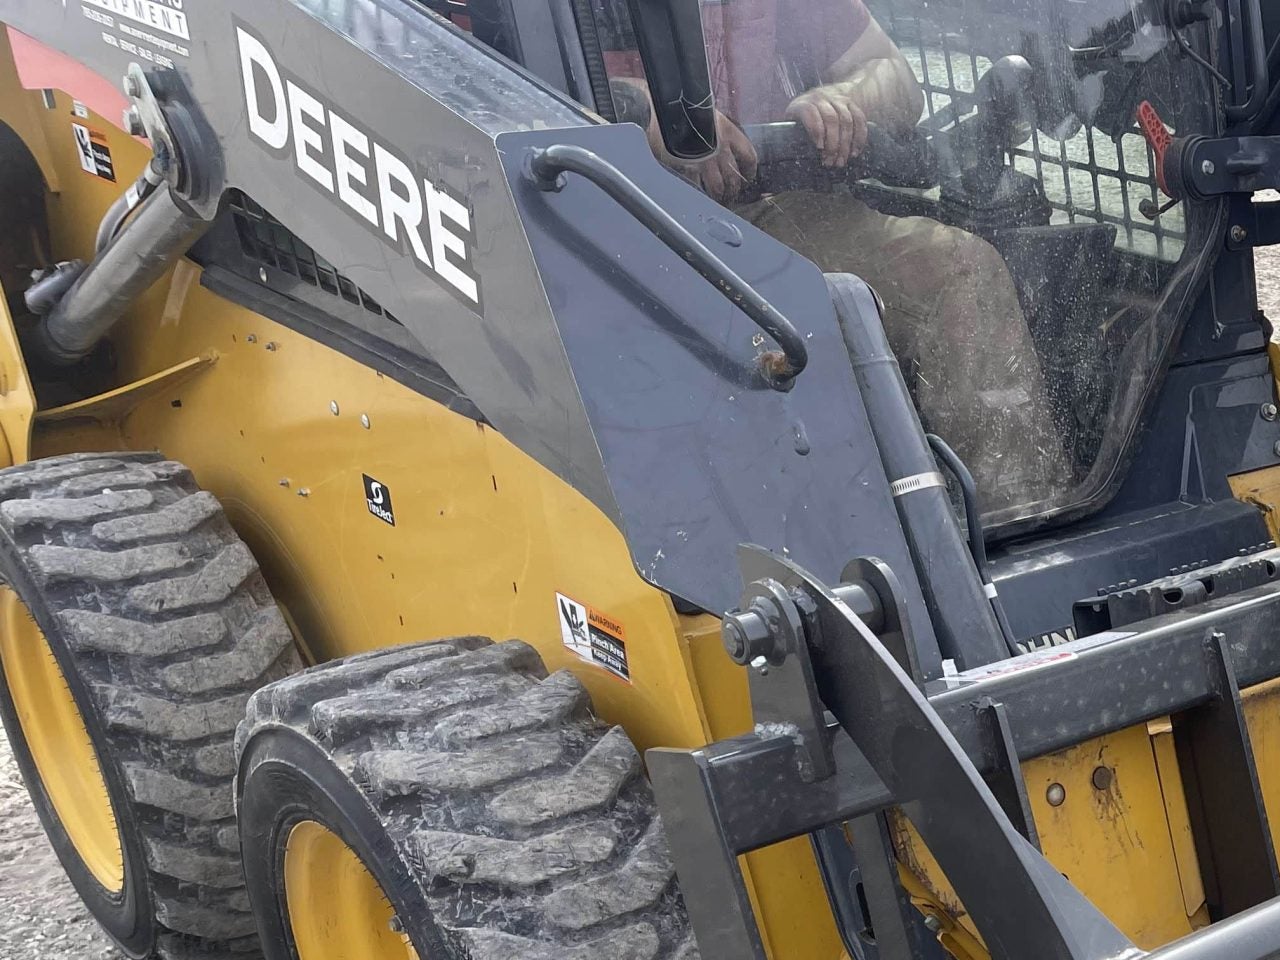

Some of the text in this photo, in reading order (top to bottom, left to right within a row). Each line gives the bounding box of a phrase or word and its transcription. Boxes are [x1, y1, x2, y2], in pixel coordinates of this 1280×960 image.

[236, 26, 479, 304] DEERE
[591, 633, 626, 660] Pinch Area
